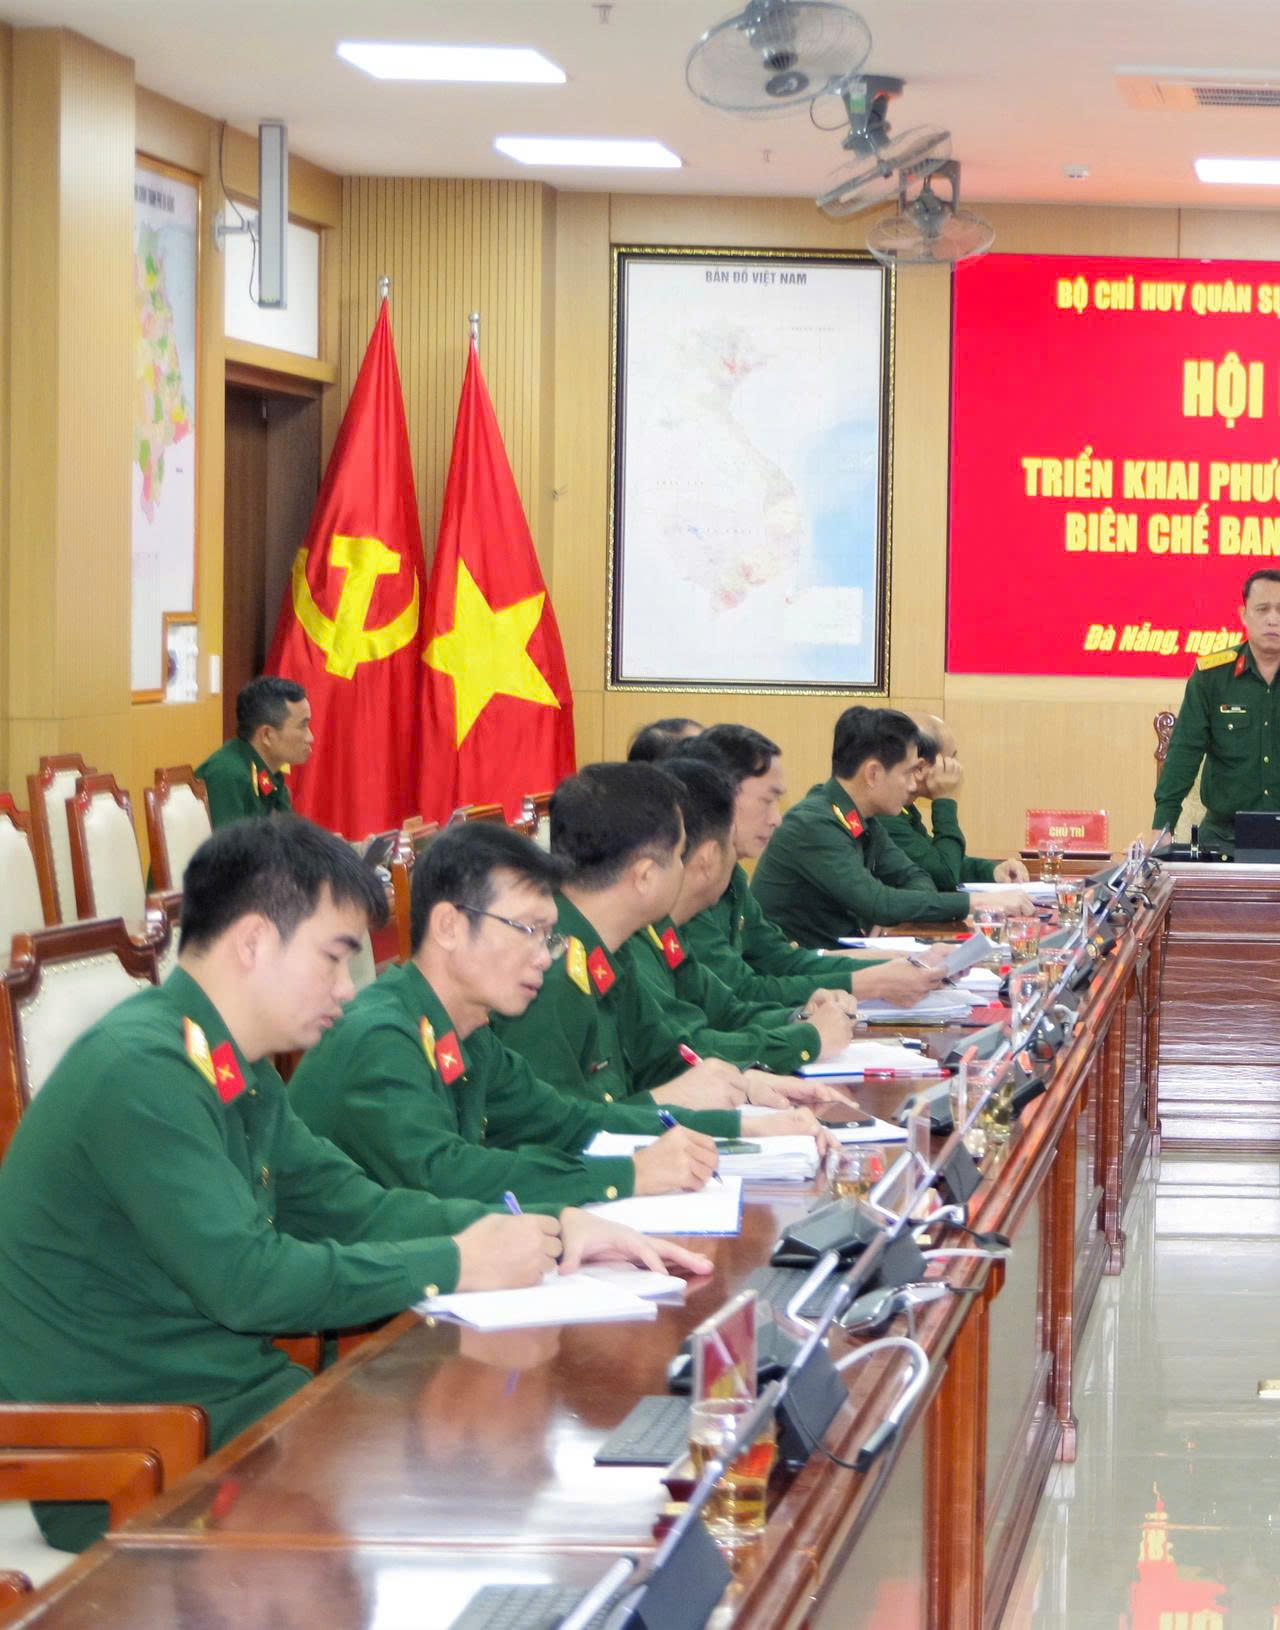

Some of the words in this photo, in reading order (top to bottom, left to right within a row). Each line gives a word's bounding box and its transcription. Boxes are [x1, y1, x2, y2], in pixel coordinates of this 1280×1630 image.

[705, 267, 730, 284] BẢN
[752, 269, 776, 287] VIỆT
[780, 272, 807, 285] NAM
[1057, 276, 1089, 314] BỘ
[1140, 282, 1186, 311] HUY
[1191, 279, 1252, 315] QUÂN
[1182, 352, 1264, 428] HỘI
[1022, 446, 1113, 499] TRIỂN
[1123, 459, 1200, 500] KHAI
[1065, 507, 1138, 553] BIÊN
[1147, 503, 1209, 555] CHẾ
[1083, 624, 1116, 651] Đà
[1184, 627, 1243, 656] ngày
